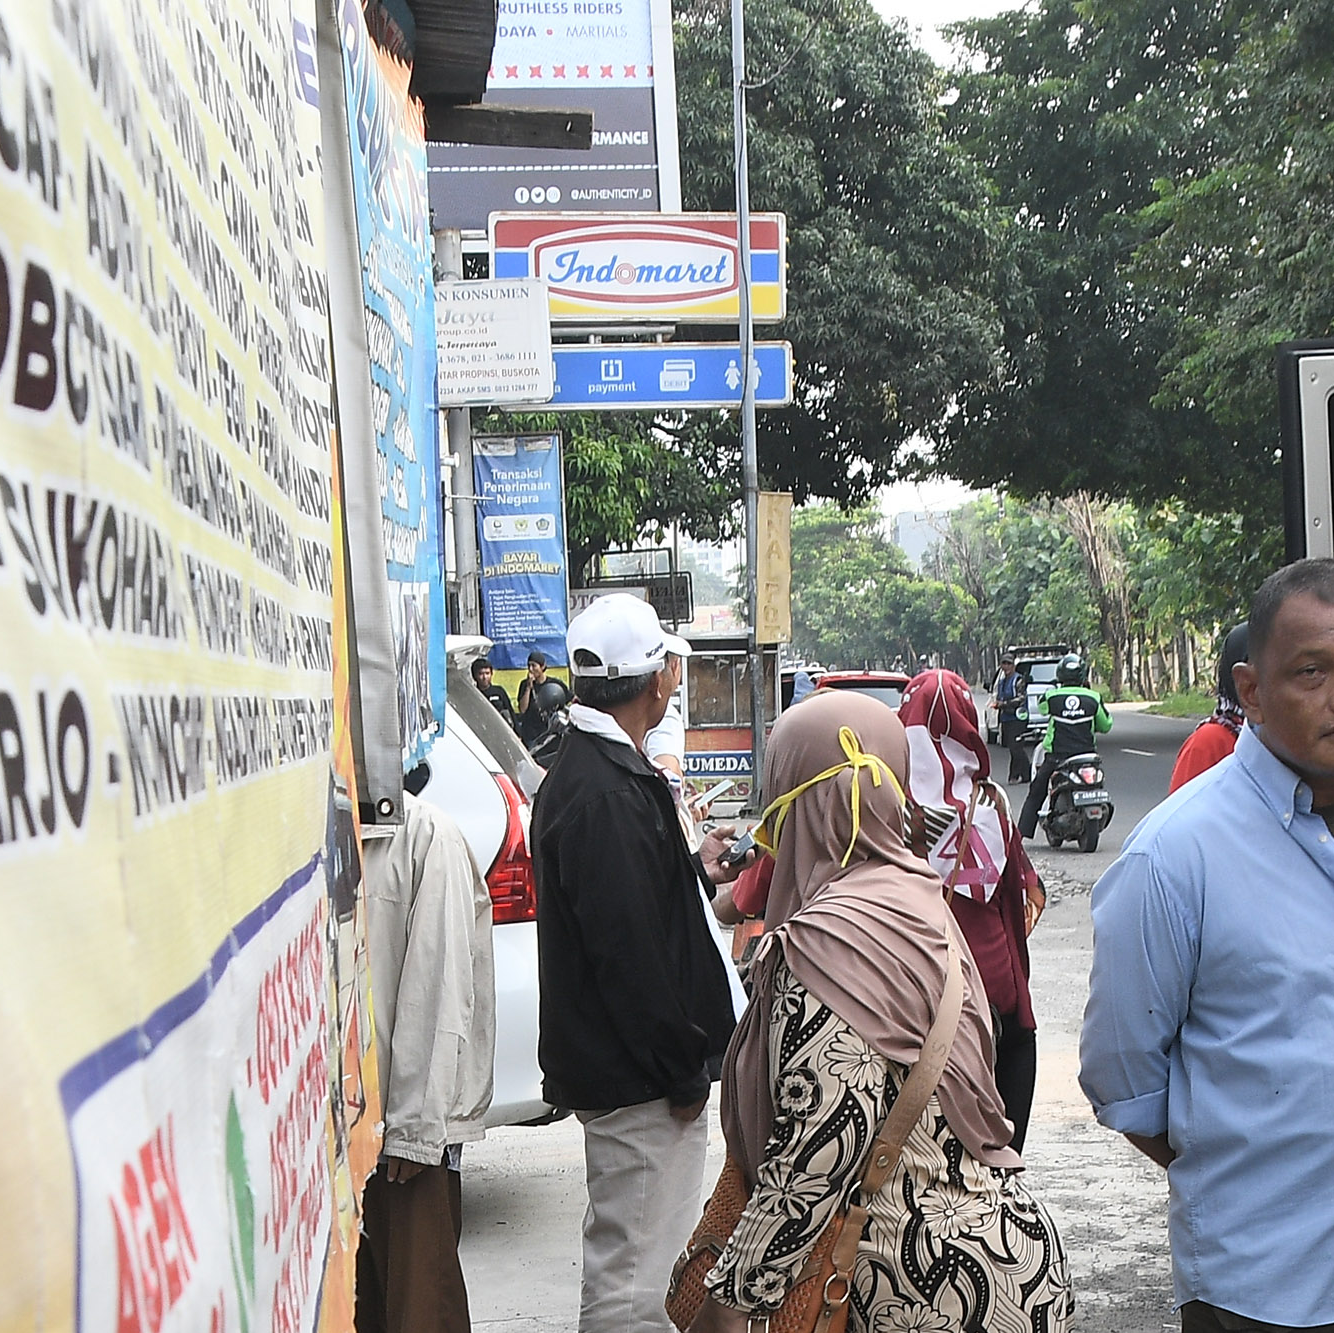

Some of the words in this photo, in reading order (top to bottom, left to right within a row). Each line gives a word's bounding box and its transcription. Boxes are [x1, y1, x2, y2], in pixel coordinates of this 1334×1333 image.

[499, 2, 568, 15] RUTHLESS
[573, 2, 623, 15] RIDERS
[499, 26, 537, 37] DAYA
[566, 25, 628, 37] MARTIALS
[548, 249, 728, 286] Indomaret
[452, 287, 530, 301] KONSUMEN
[437, 309, 495, 326] Jaya
[502, 367, 540, 377] BUSKOTA
[588, 381, 637, 395] payment
[490, 467, 543, 481] Transaksi
[483, 480, 551, 493] Penerimaan
[496, 493, 540, 507] Negara
[503, 552, 539, 564] BAYAR
[483, 567, 495, 578] DI
[496, 563, 560, 576] INDOMARET
[682, 756, 753, 772] SUMEDA
